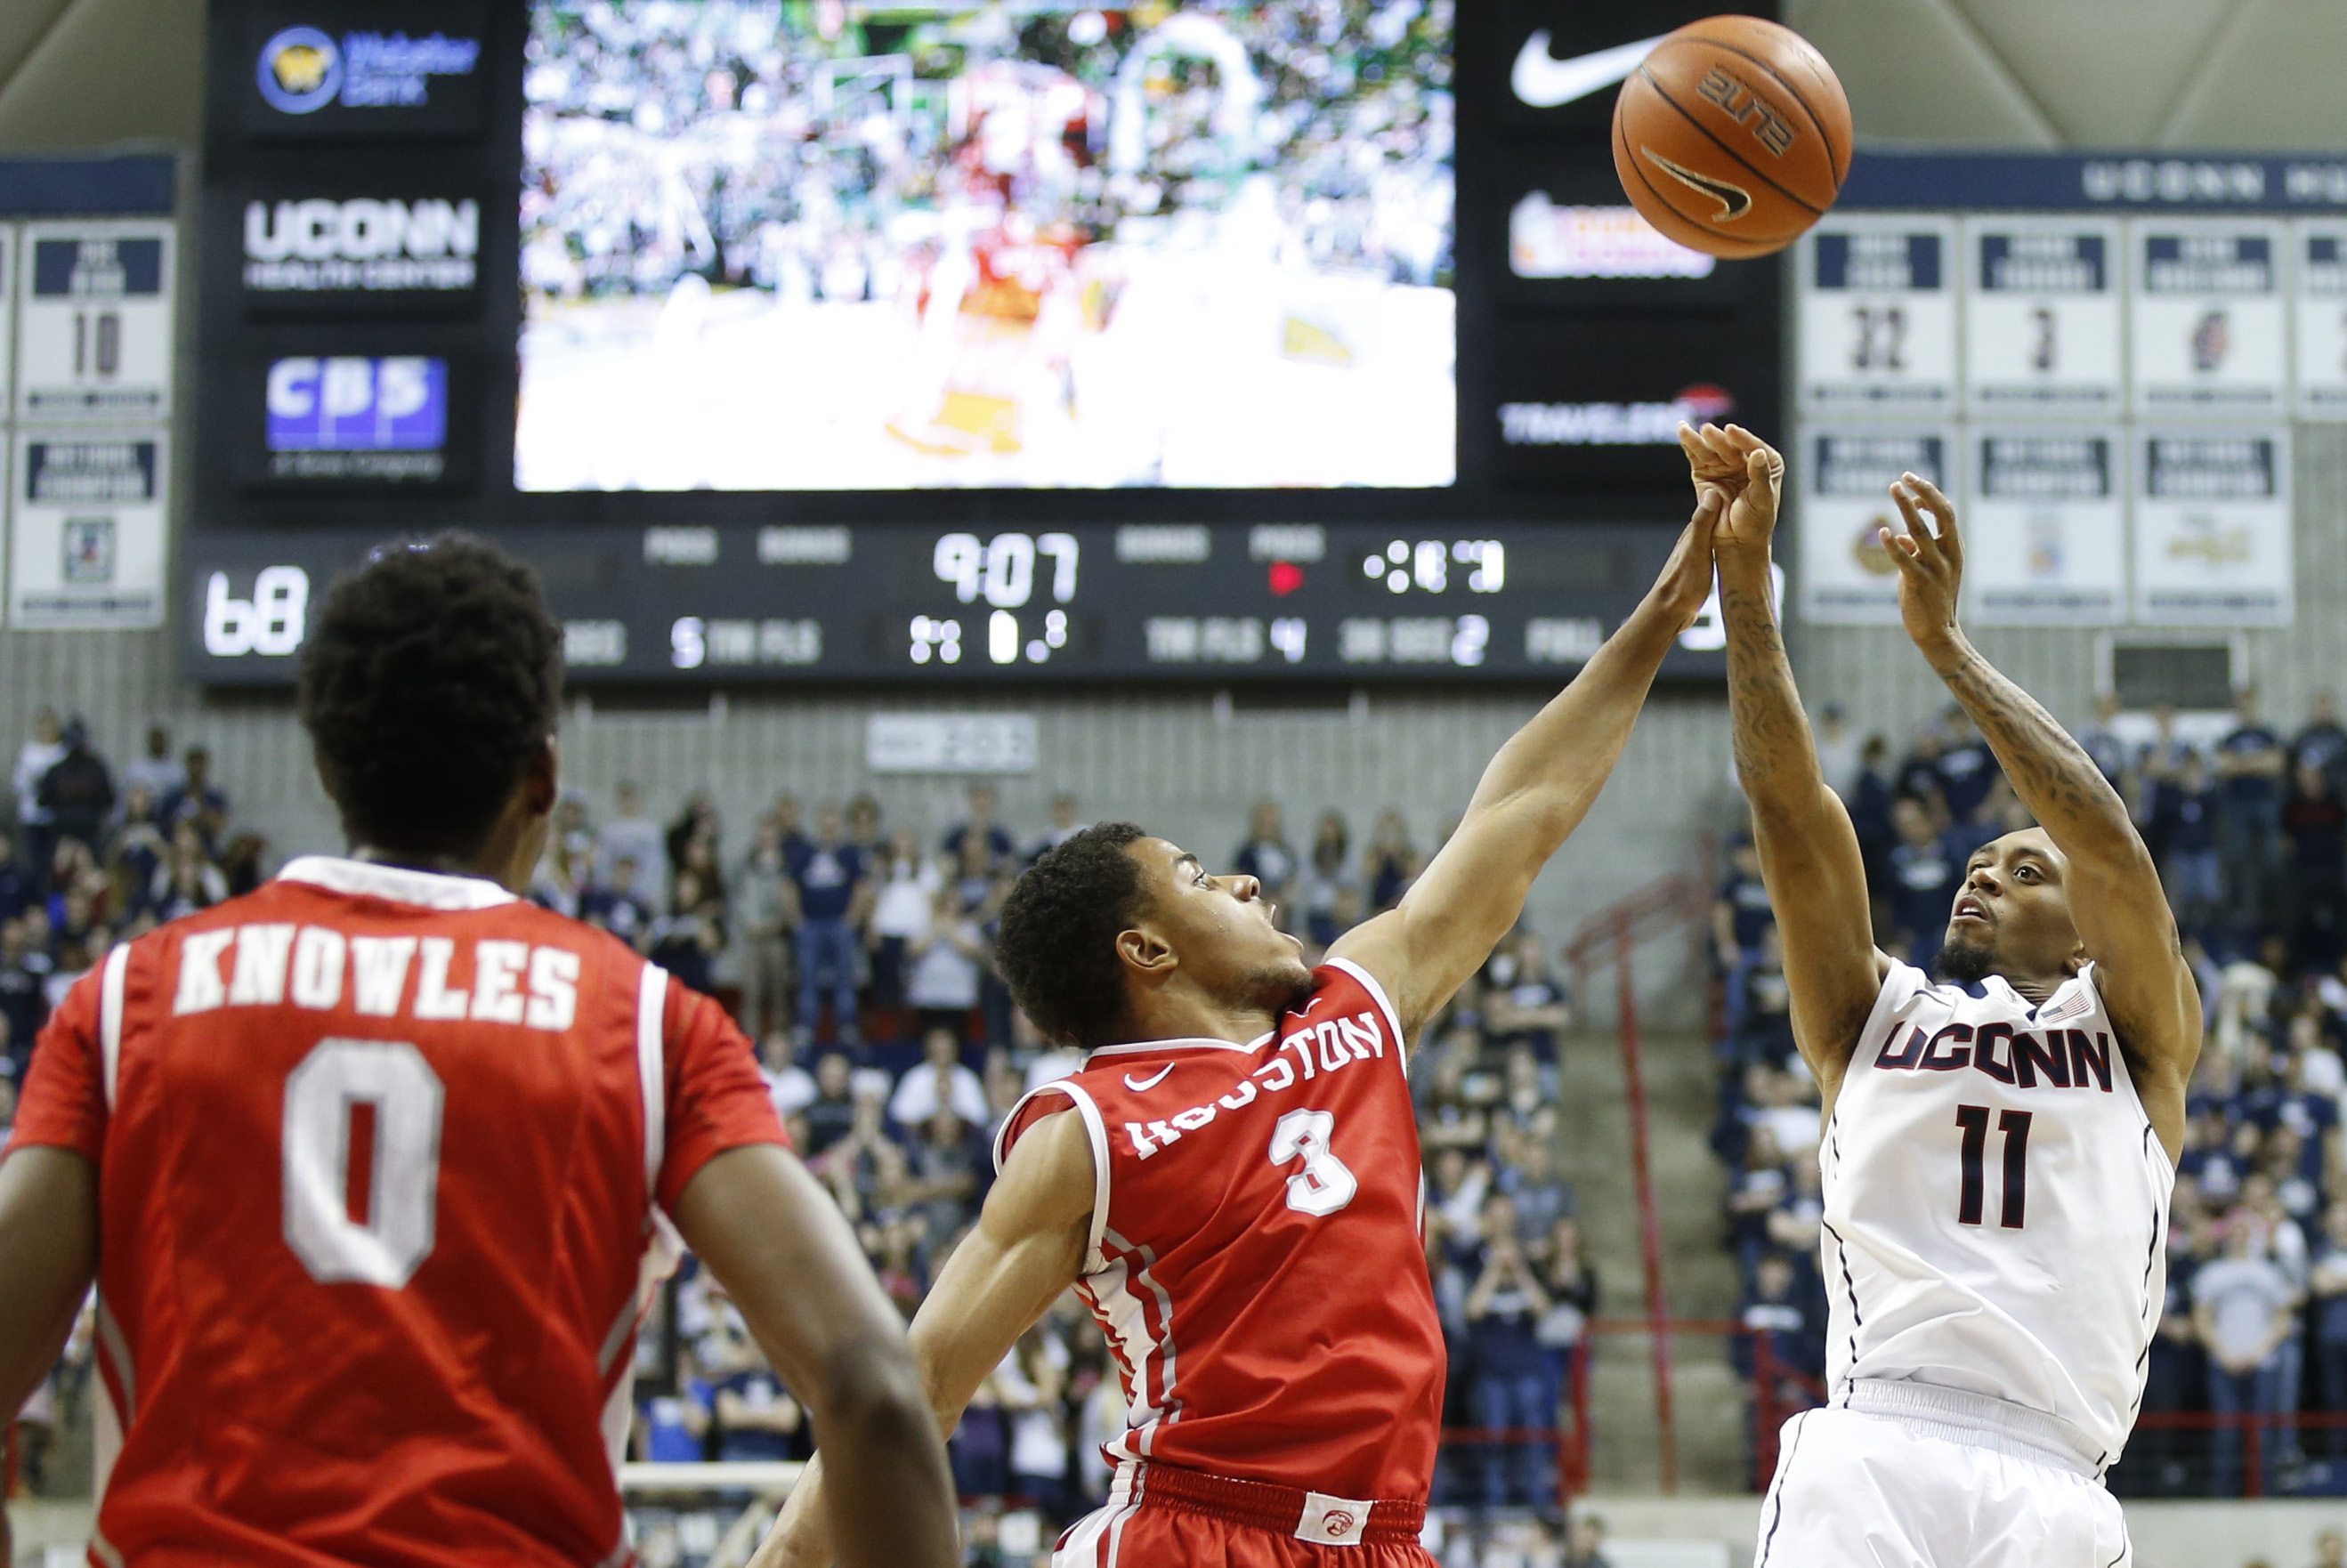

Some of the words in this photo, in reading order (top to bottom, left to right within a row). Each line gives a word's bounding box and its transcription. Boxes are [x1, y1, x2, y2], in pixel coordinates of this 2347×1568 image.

[1696, 69, 1795, 159] ELITE
[2083, 160, 2266, 202] UCONN
[244, 198, 479, 261] UCONN
[268, 356, 431, 418] CBS
[935, 533, 1079, 606] 9:07
[1270, 617, 1307, 663] 4
[1452, 614, 1490, 666] 2
[173, 923, 580, 1032] KNOWLES
[1124, 1011, 1383, 1160] HOUSTON
[1874, 1021, 2113, 1093] UCONN
[283, 1036, 445, 1290] 0
[1268, 1107, 1358, 1216] 3
[1955, 1104, 2033, 1229] 11
